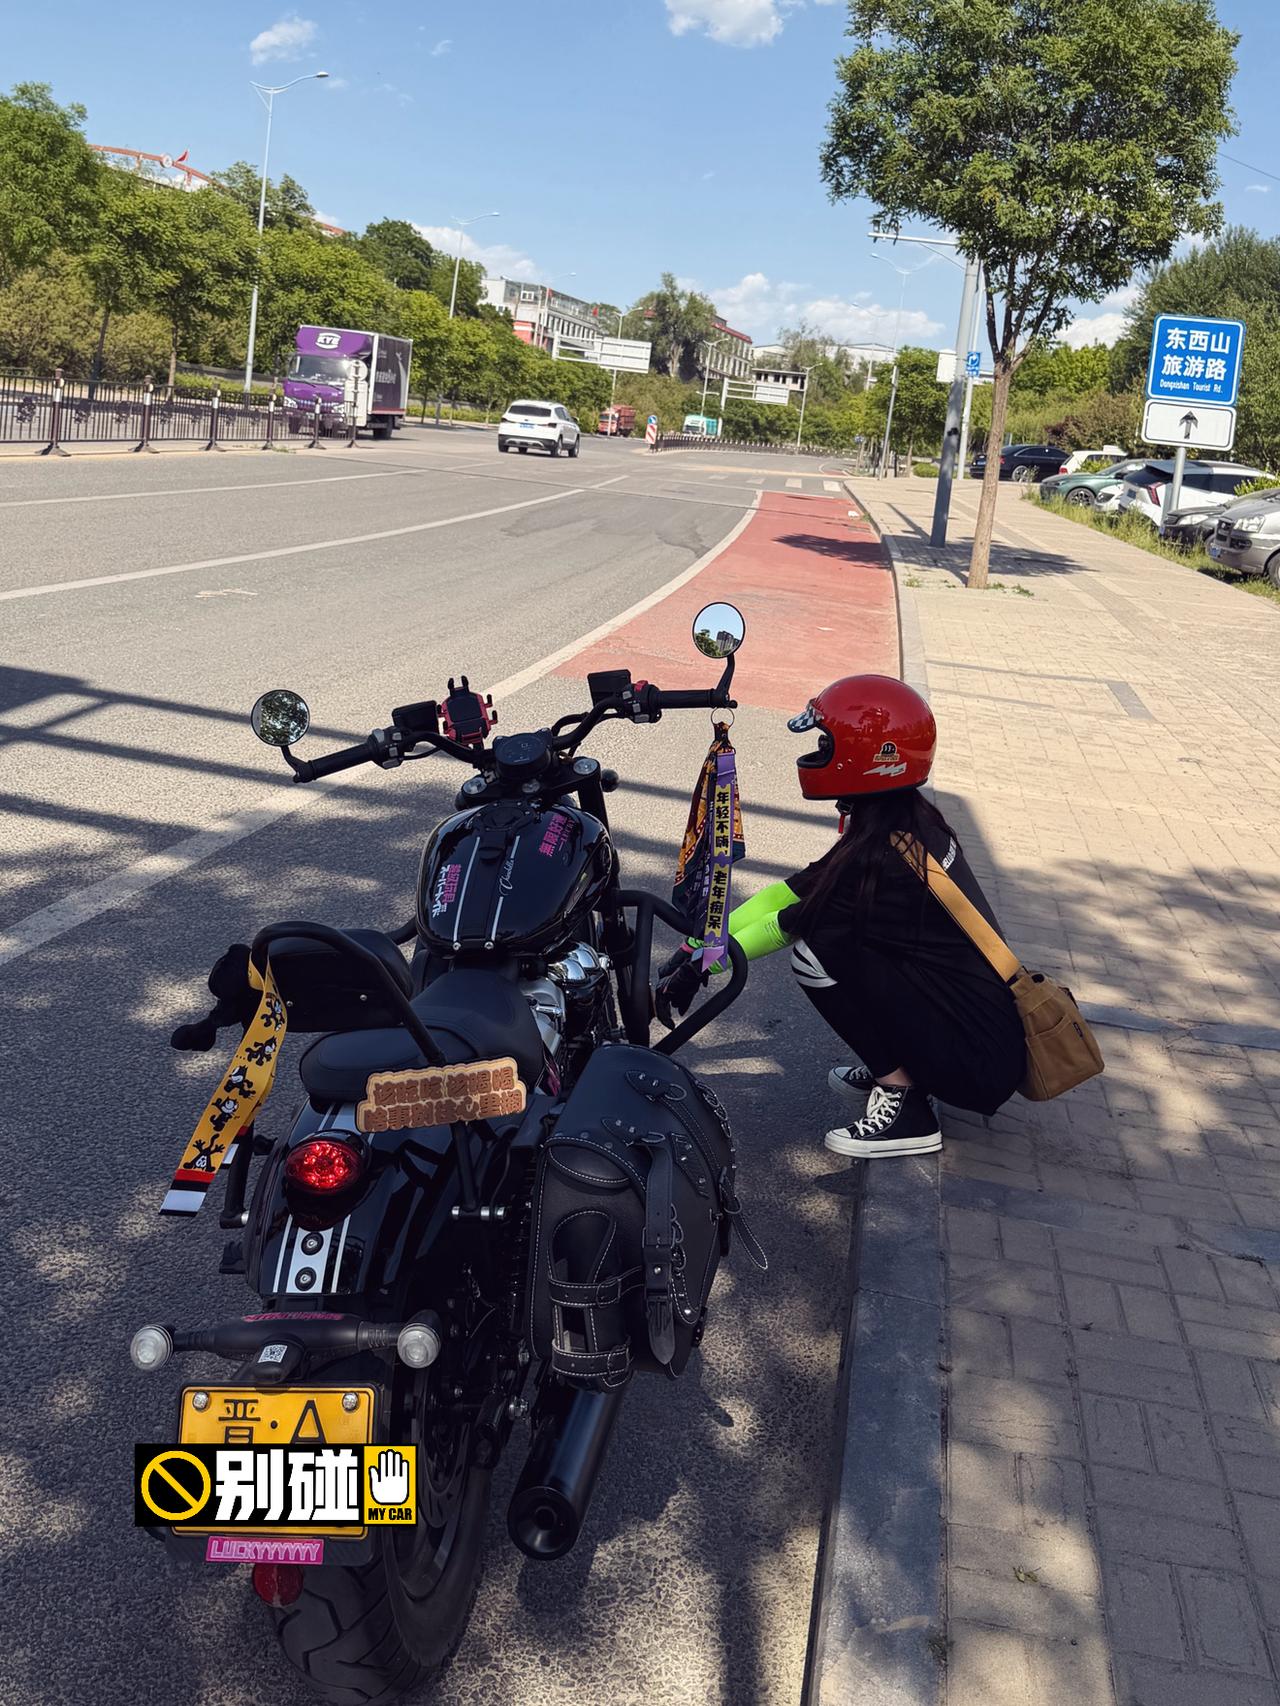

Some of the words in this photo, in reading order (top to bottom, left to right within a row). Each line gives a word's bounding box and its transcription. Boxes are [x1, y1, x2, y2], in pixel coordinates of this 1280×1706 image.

[1165, 327, 1231, 354] 东西山
[1161, 353, 1227, 381] 旅游路
[1193, 382, 1211, 392] Tourist
[708, 870, 728, 930] 老年痴呆
